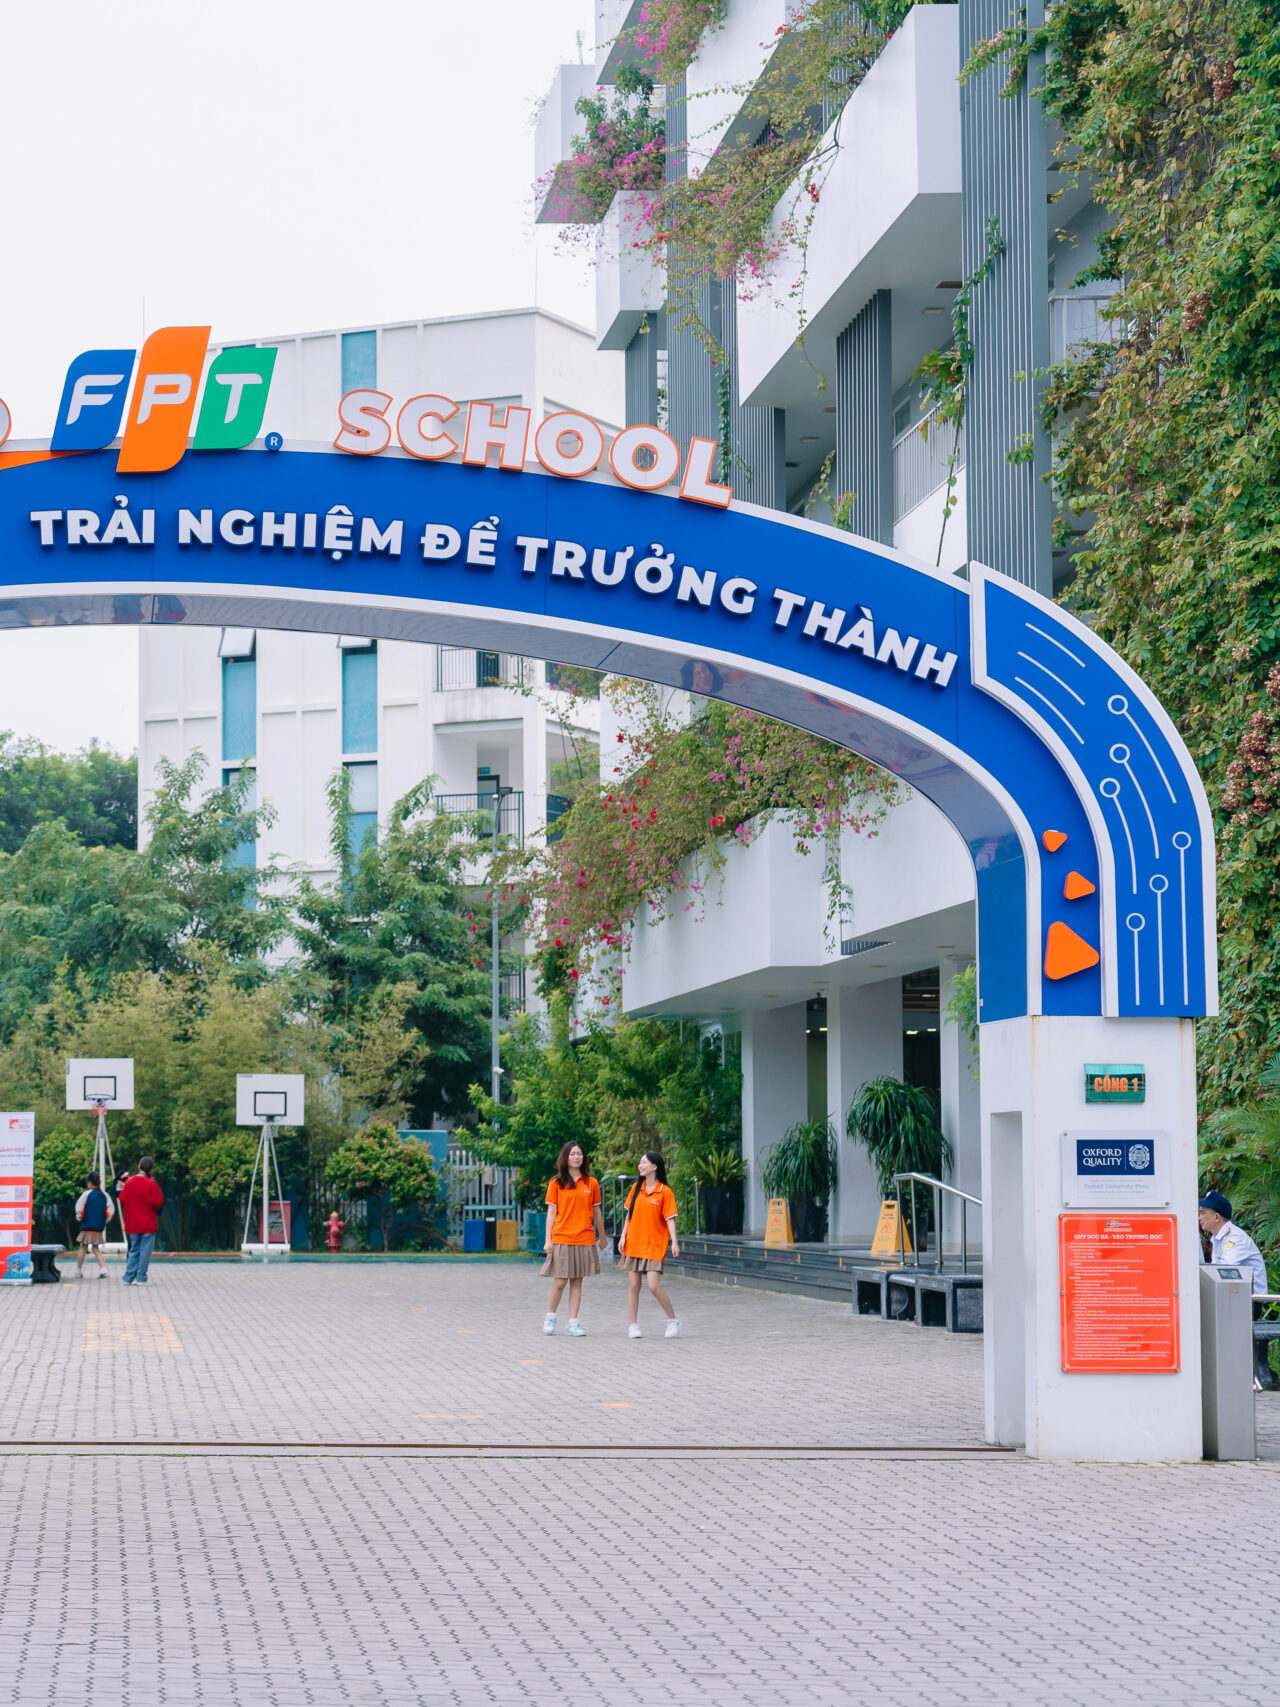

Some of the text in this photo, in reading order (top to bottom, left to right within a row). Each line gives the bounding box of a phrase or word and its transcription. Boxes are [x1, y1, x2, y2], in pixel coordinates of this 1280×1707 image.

[333, 389, 733, 509] SCHOOL
[30, 494, 959, 688] TRẢI NGHIỆM ĐỂ TRƯỞNG THÀNH
[1132, 1077, 1139, 1092] 1
[1082, 1148, 1122, 1157] OXFORD
[1082, 1158, 1122, 1168] QUALITY
